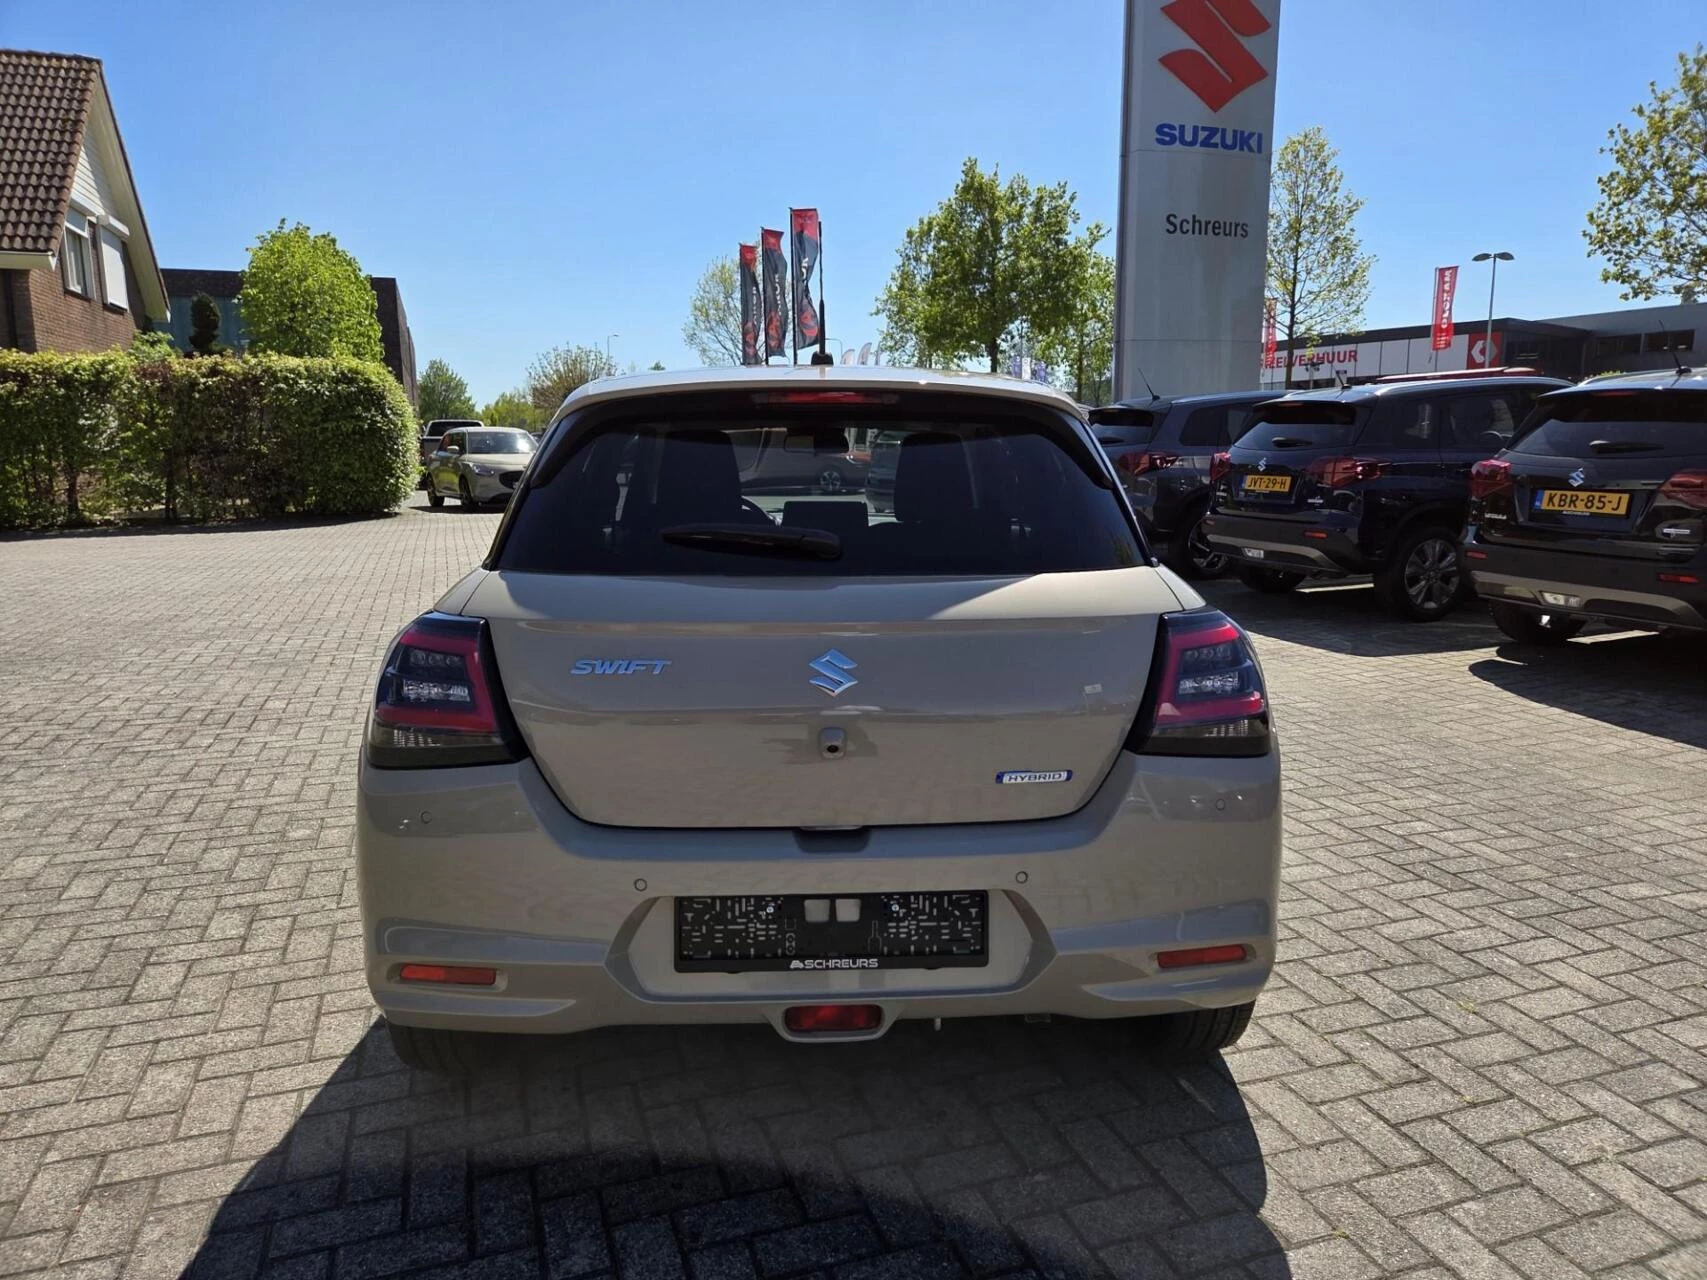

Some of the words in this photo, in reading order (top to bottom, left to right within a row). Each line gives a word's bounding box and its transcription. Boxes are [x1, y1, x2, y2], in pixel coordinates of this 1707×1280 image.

[1155, 123, 1262, 154] SUZUKI
[1166, 213, 1249, 238] Schreurs
[1248, 477, 1287, 490] JVT-29-H
[1546, 492, 1624, 511] KBR-85-J
[570, 659, 672, 674] SWIFT
[1008, 773, 1062, 782] HYBRID
[804, 959, 878, 969] SCHREURS
